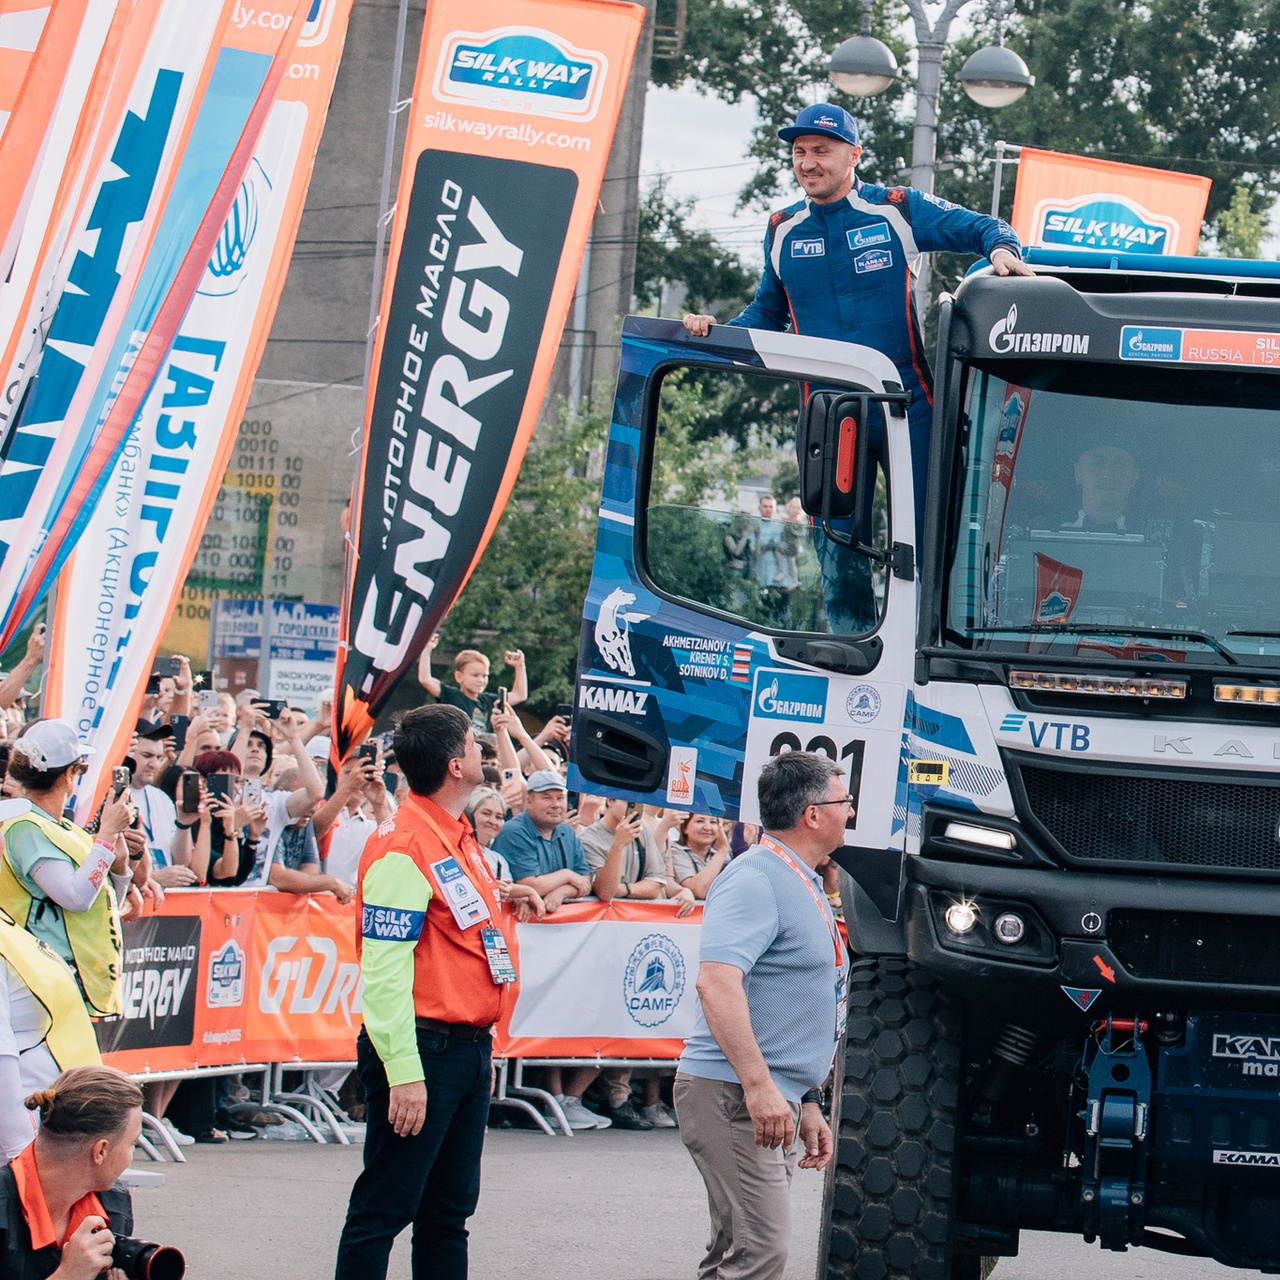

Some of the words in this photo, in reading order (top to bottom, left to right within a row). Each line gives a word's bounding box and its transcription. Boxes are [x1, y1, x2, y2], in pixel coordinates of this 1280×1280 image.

[454, 50, 526, 76] SILK
[526, 61, 591, 85] WAY
[482, 72, 553, 90] RALLY
[424, 111, 591, 151] silkwayrally.com
[1045, 214, 1109, 237] SILK
[1110, 222, 1166, 246] WAY
[803, 242, 823, 255] VTB
[1073, 234, 1134, 249] RALLY
[858, 256, 888, 268] KAMAZ
[1014, 332, 1090, 355] ГАЗПРОМ
[1188, 347, 1244, 362] RUSSIA
[354, 195, 524, 673] ENERGY
[662, 634, 726, 653] AKHMETZIANOV
[689, 652, 722, 667] KRENEV
[679, 664, 719, 678] SOTNIKOV
[578, 685, 649, 716] KAMAZ
[776, 699, 823, 718] GAZPROM
[849, 709, 876, 718] CAMF
[1029, 721, 1091, 751] VTB
[374, 909, 412, 926] SILK
[375, 922, 412, 939] WAY
[630, 997, 674, 1011] CAMF
